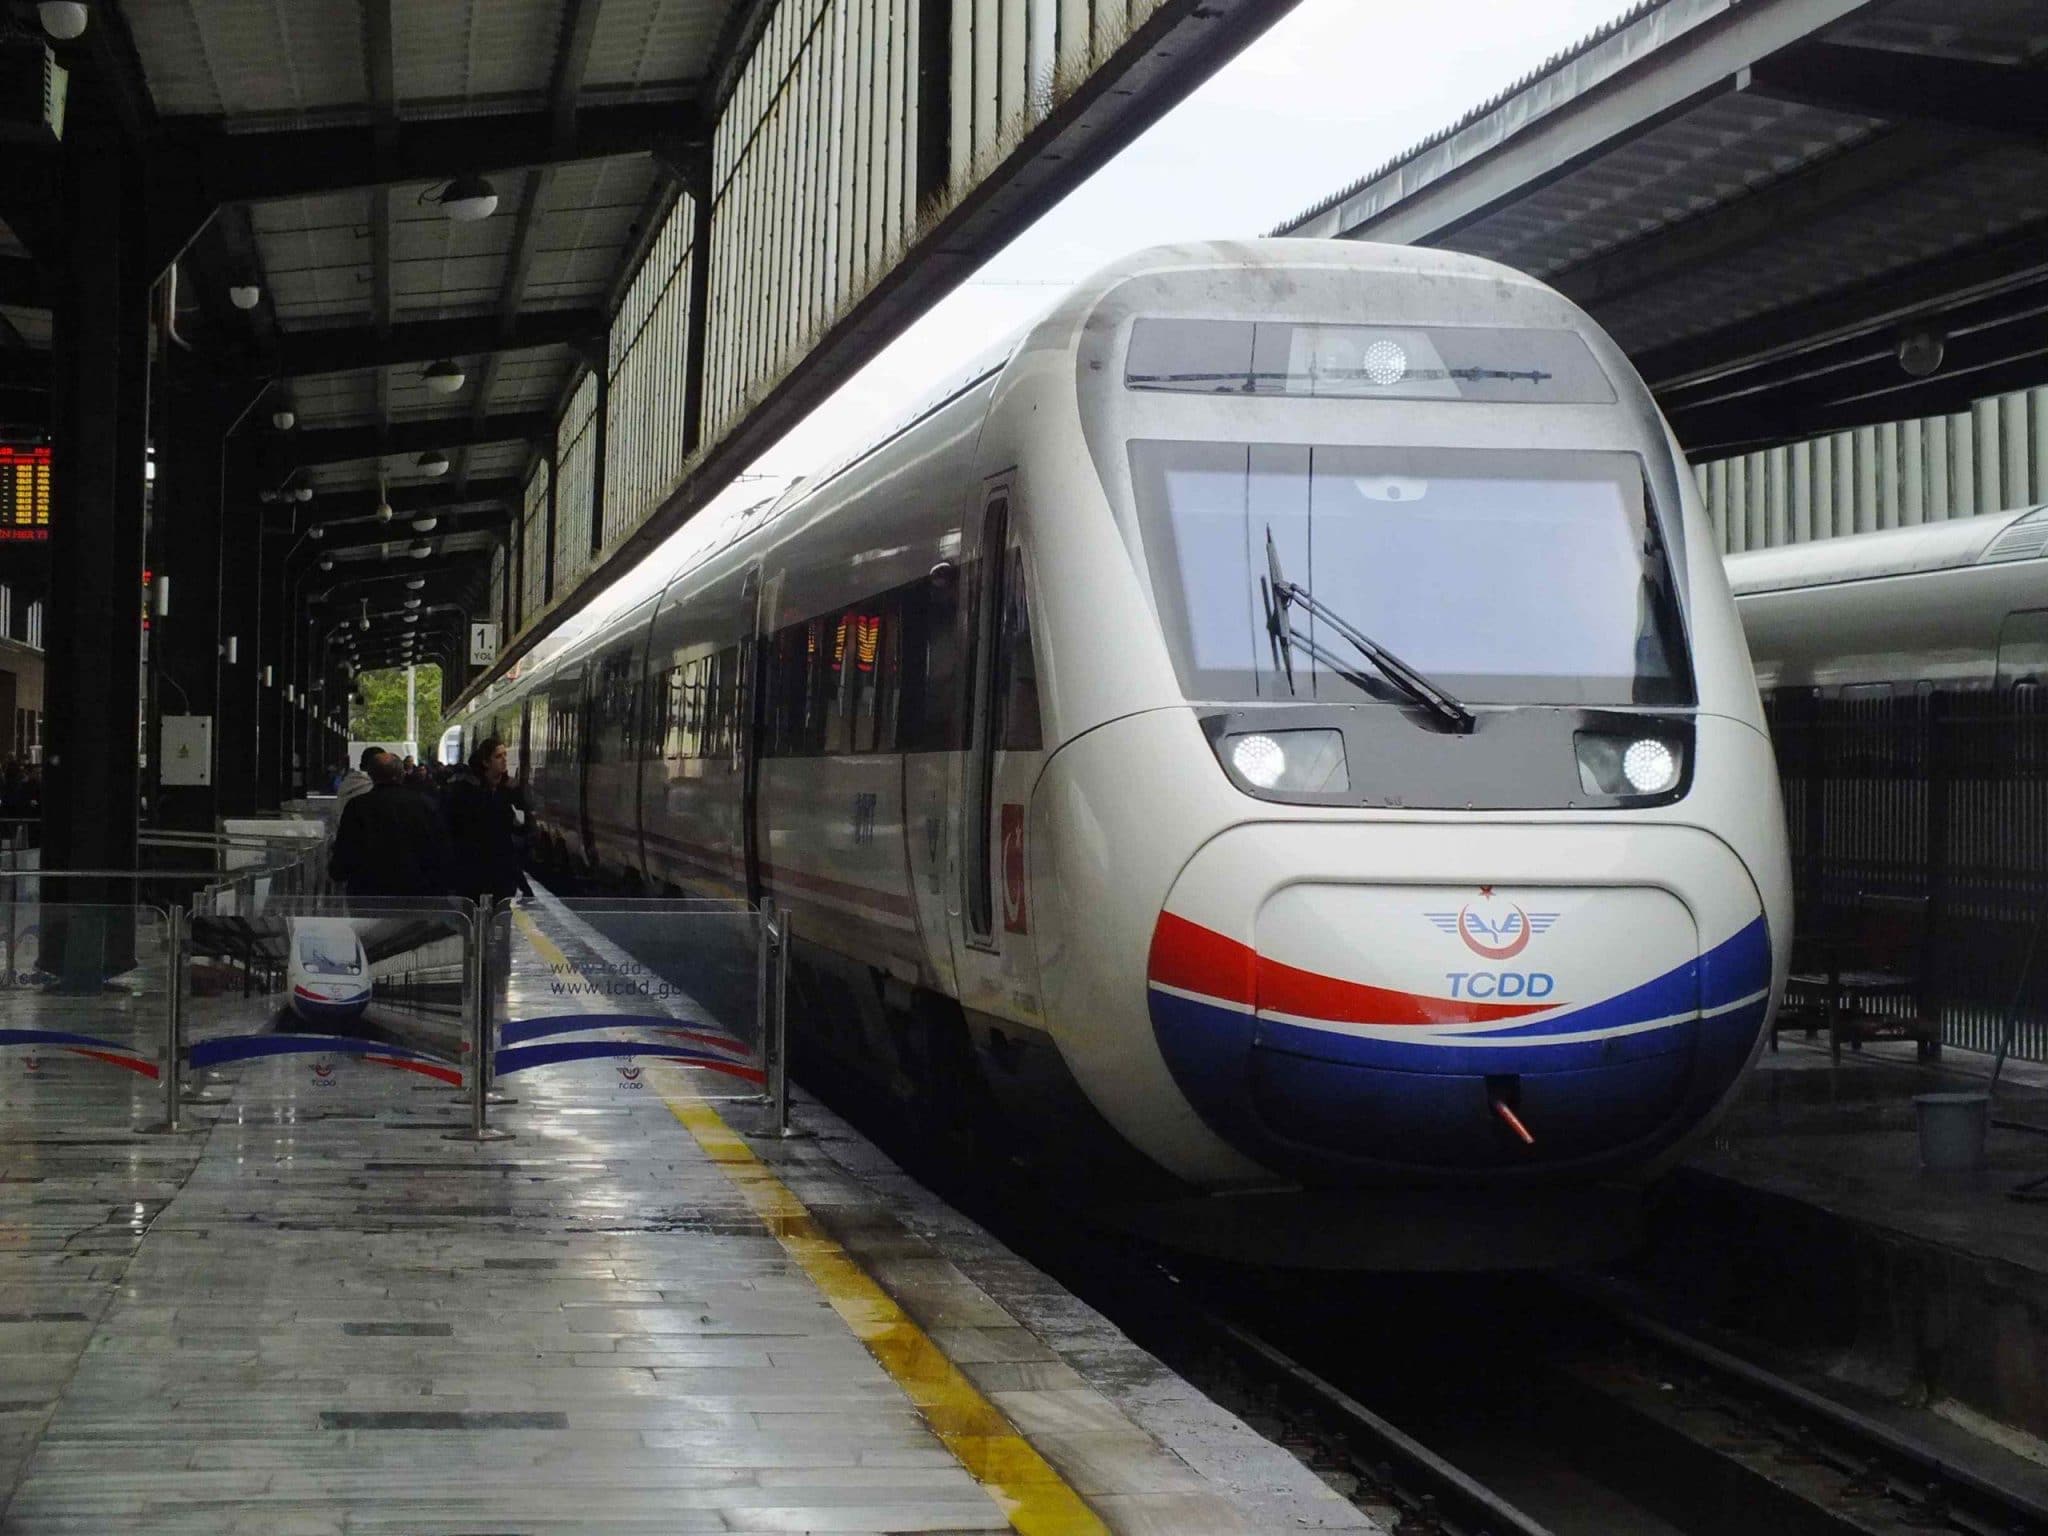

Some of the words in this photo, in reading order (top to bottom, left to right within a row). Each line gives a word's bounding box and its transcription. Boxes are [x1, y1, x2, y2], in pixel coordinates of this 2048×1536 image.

[477, 628, 492, 649] 1.
[1445, 971, 1554, 998] TCDD
[311, 1079, 337, 1087] TCDD
[619, 1081, 644, 1090] TCDD
